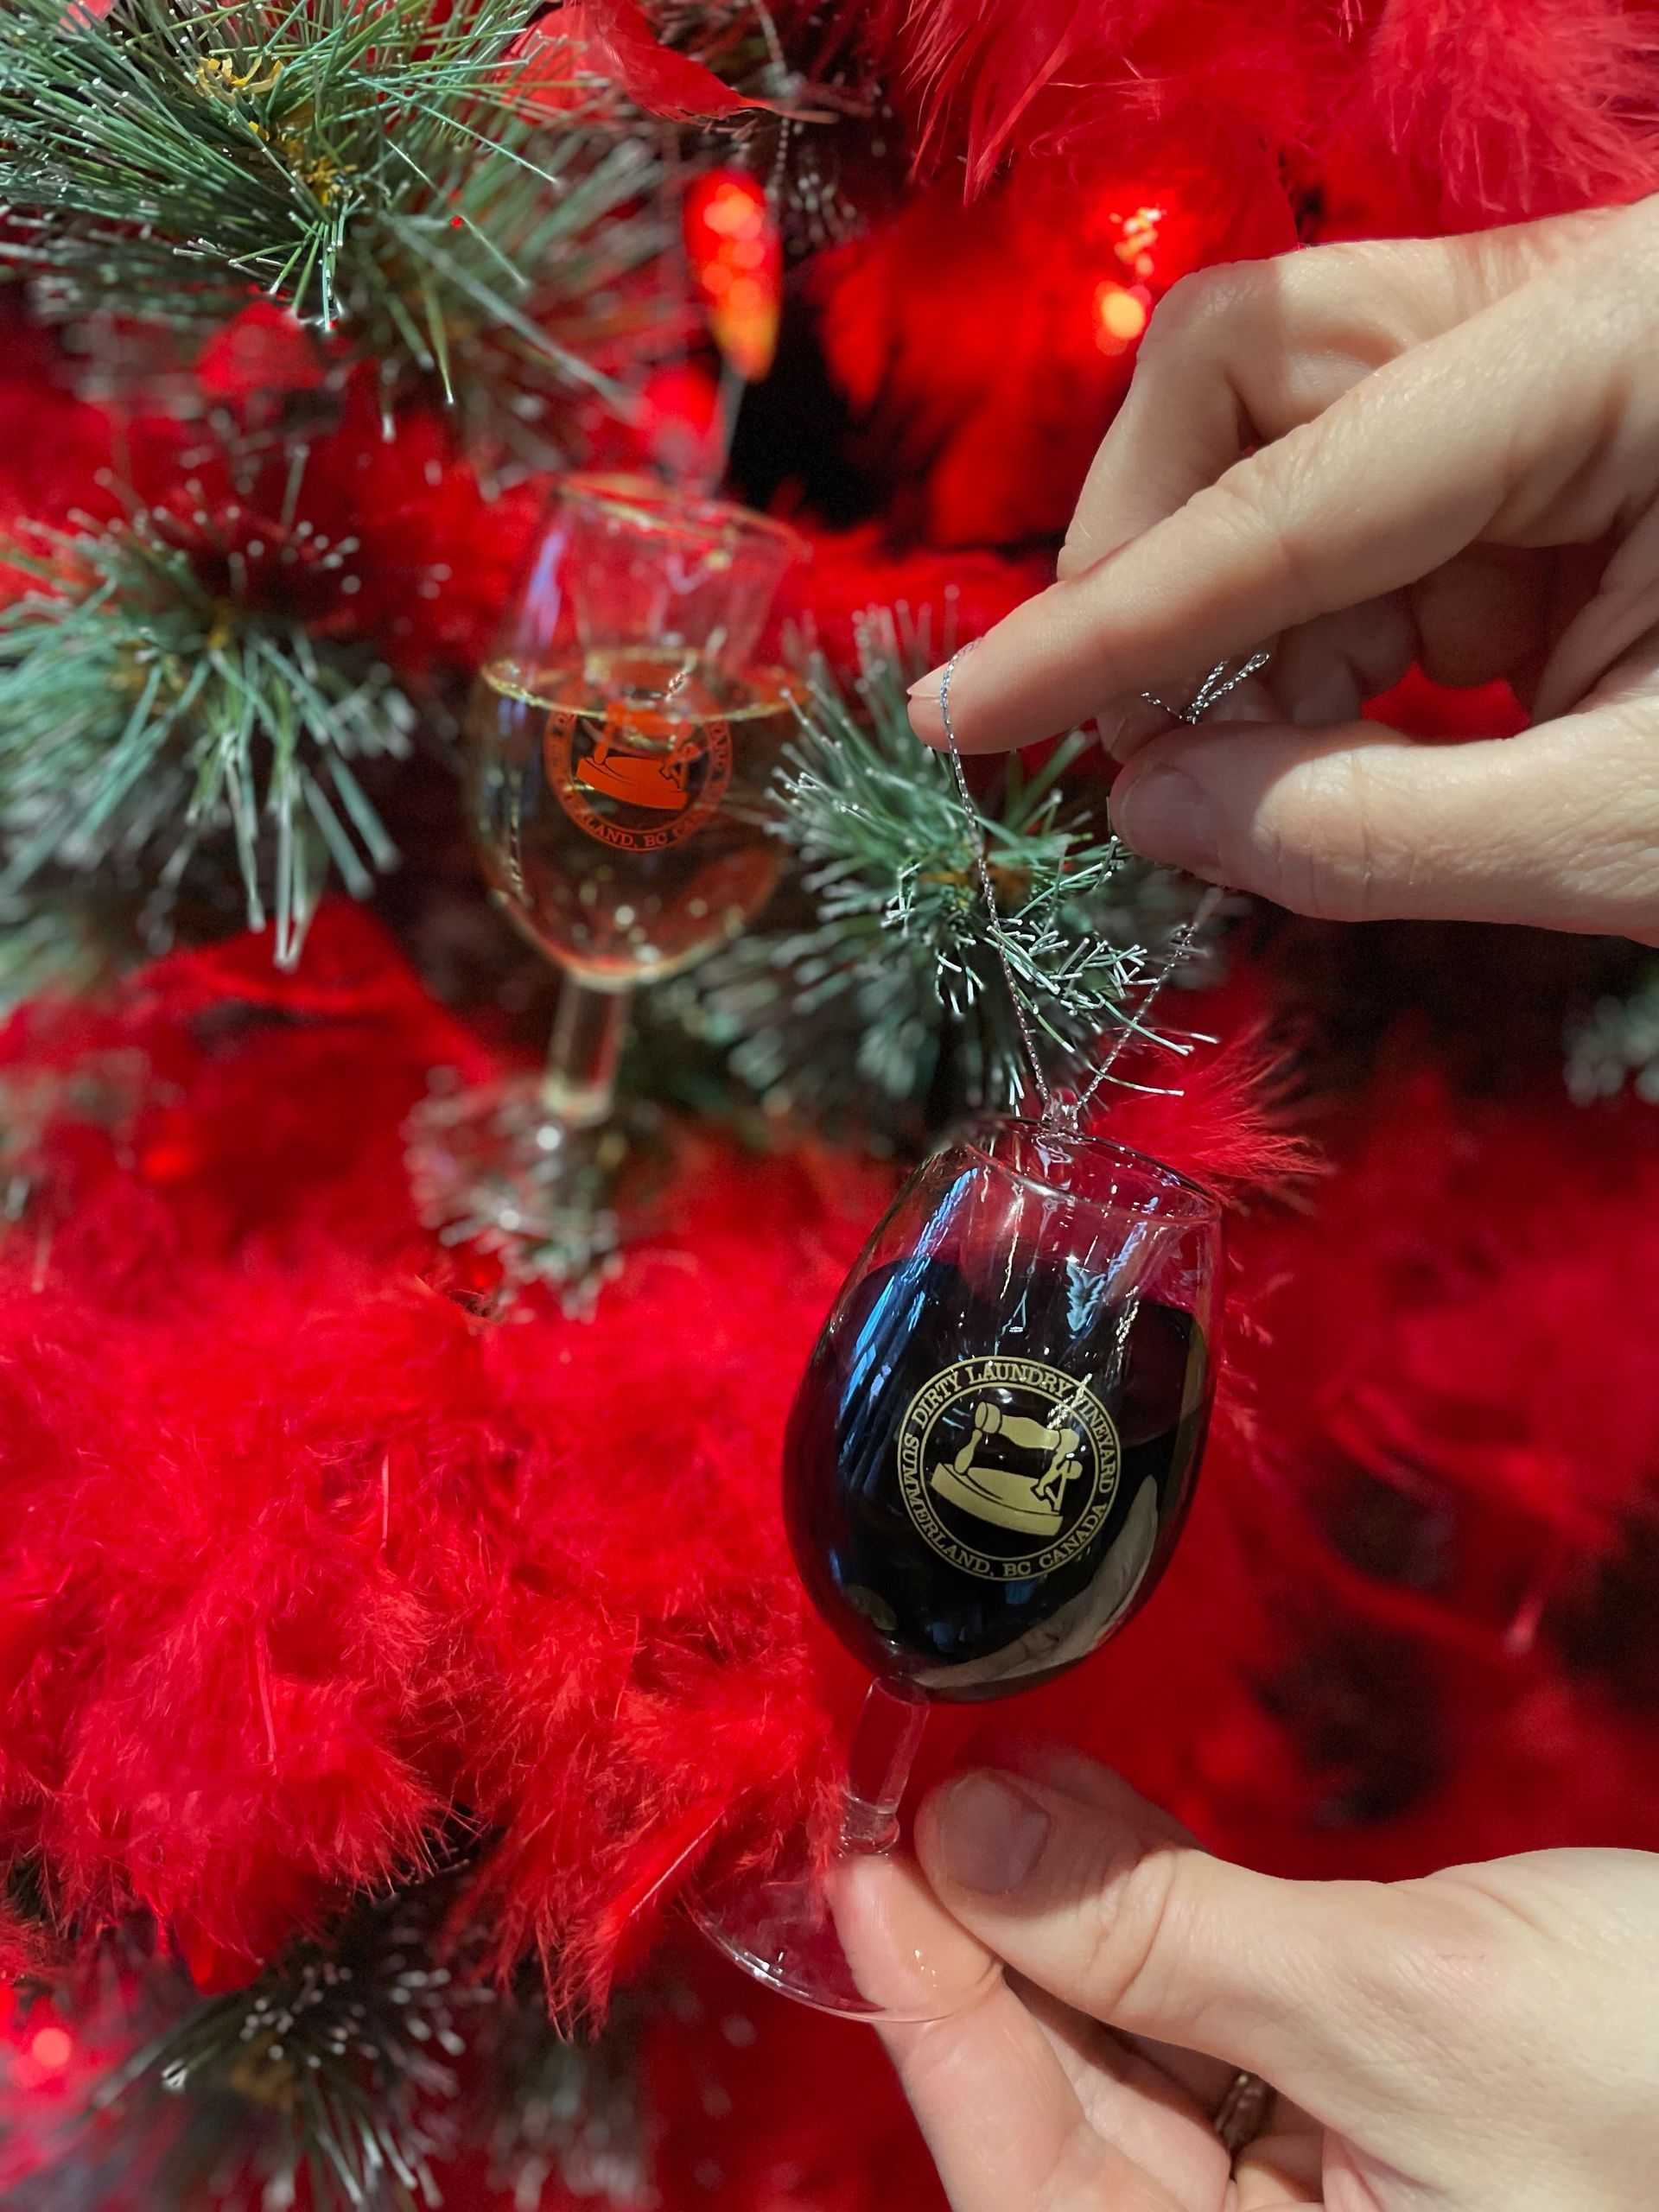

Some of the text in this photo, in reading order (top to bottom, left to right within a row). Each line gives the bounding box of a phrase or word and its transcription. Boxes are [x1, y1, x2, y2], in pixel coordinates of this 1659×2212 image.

[912, 1363, 1116, 1492] DIRTY LAUNDRY VINEYARD
[901, 1433, 1107, 1578] SUMMERLAND, BC CANADA
